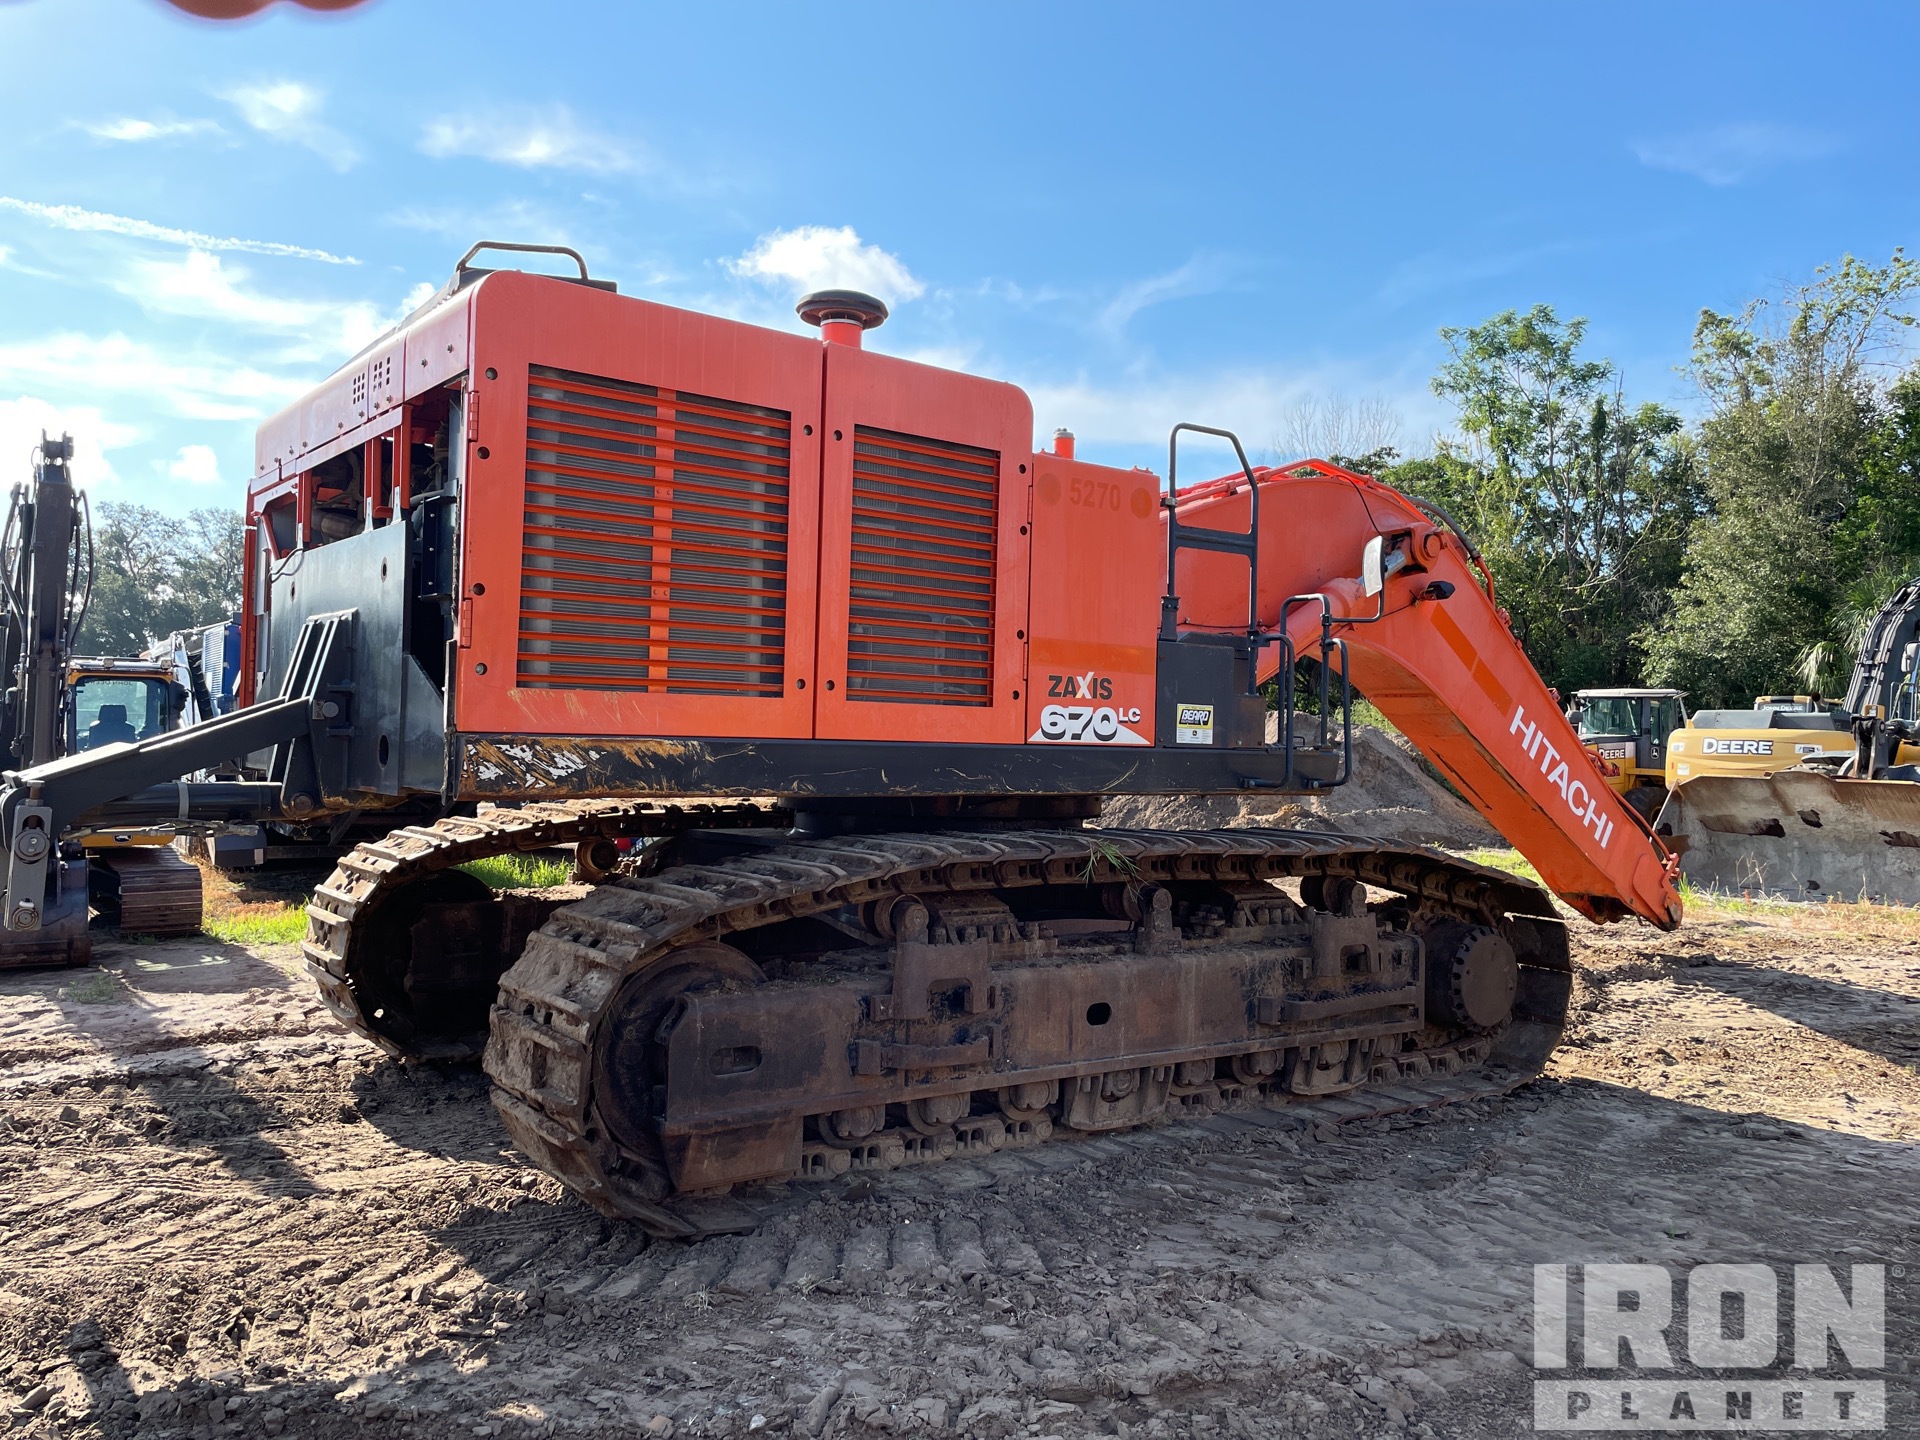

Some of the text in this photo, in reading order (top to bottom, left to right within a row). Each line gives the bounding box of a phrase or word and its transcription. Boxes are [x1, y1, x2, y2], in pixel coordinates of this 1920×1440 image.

[1070, 477, 1121, 512] 5270
[1047, 671, 1113, 700] ZAXIS
[1040, 704, 1118, 742] 670
[1181, 709, 1210, 726] BEARD
[1598, 748, 1625, 760] DEERE
[1702, 737, 1773, 755] DEERE
[1509, 705, 1614, 849] HITACHI
